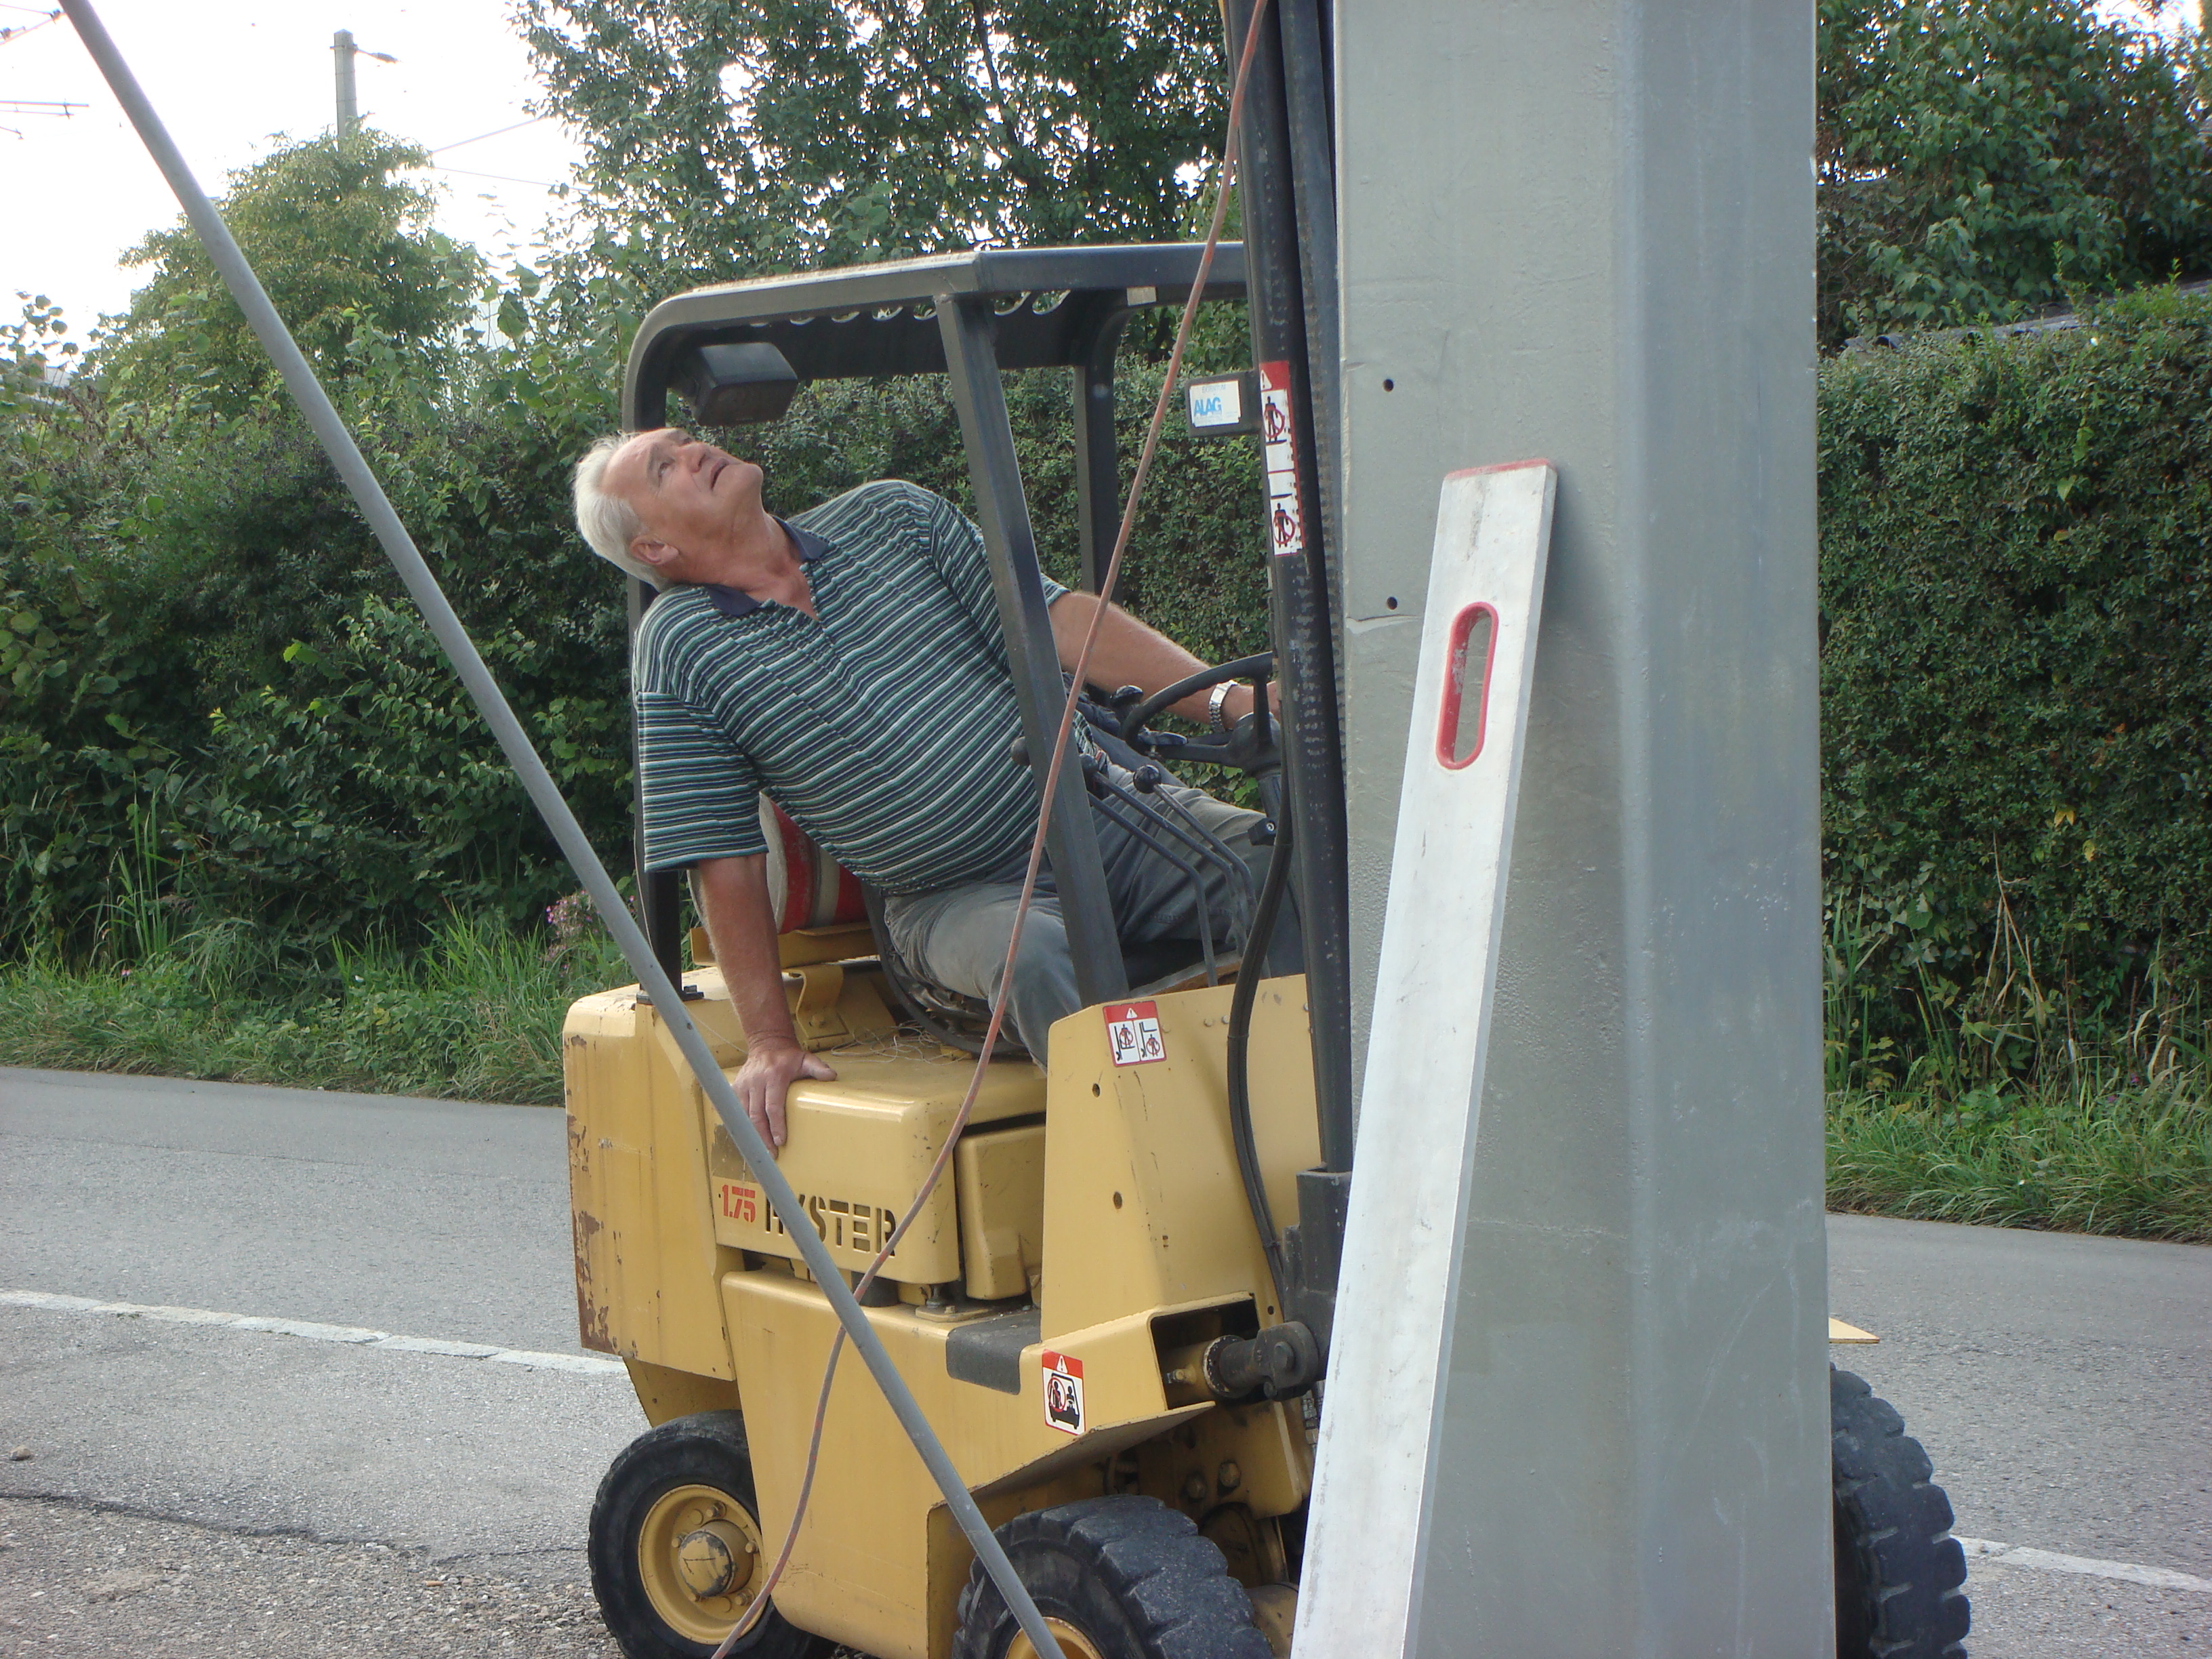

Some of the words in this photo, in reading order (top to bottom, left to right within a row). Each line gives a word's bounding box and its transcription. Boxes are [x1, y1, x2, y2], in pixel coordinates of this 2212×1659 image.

[1194, 396, 1222, 416] ALAG
[722, 1184, 756, 1223] 1.75
[766, 1194, 896, 1256] HSTER
